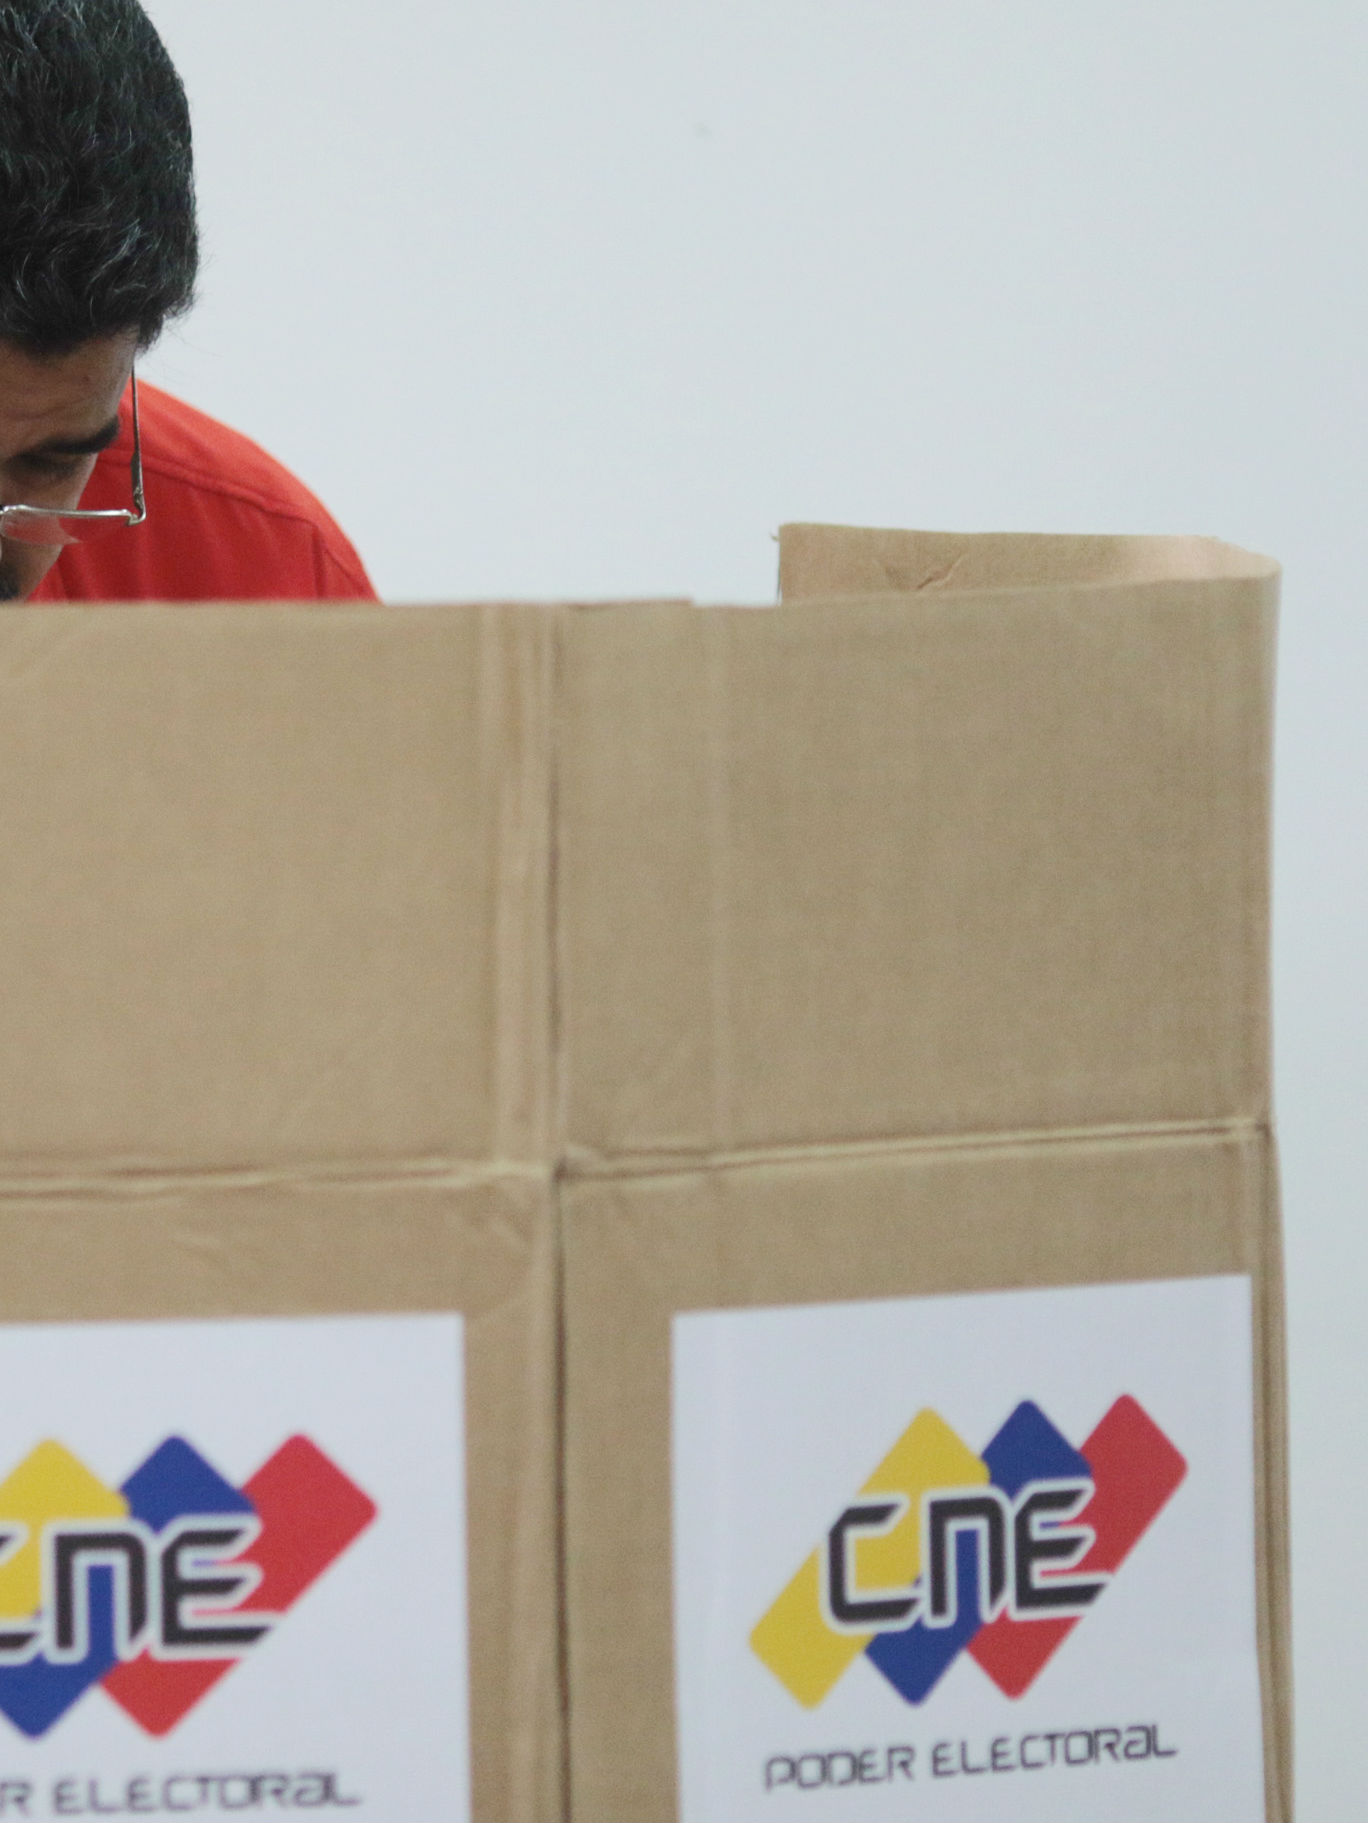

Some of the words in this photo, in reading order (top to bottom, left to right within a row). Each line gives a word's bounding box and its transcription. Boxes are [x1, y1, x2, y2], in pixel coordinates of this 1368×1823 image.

[829, 1487, 1109, 1622] CNE
[765, 1744, 916, 1791] PODER
[932, 1722, 1178, 1777] ELECTORAL
[53, 1769, 360, 1814] ELECTORAL
